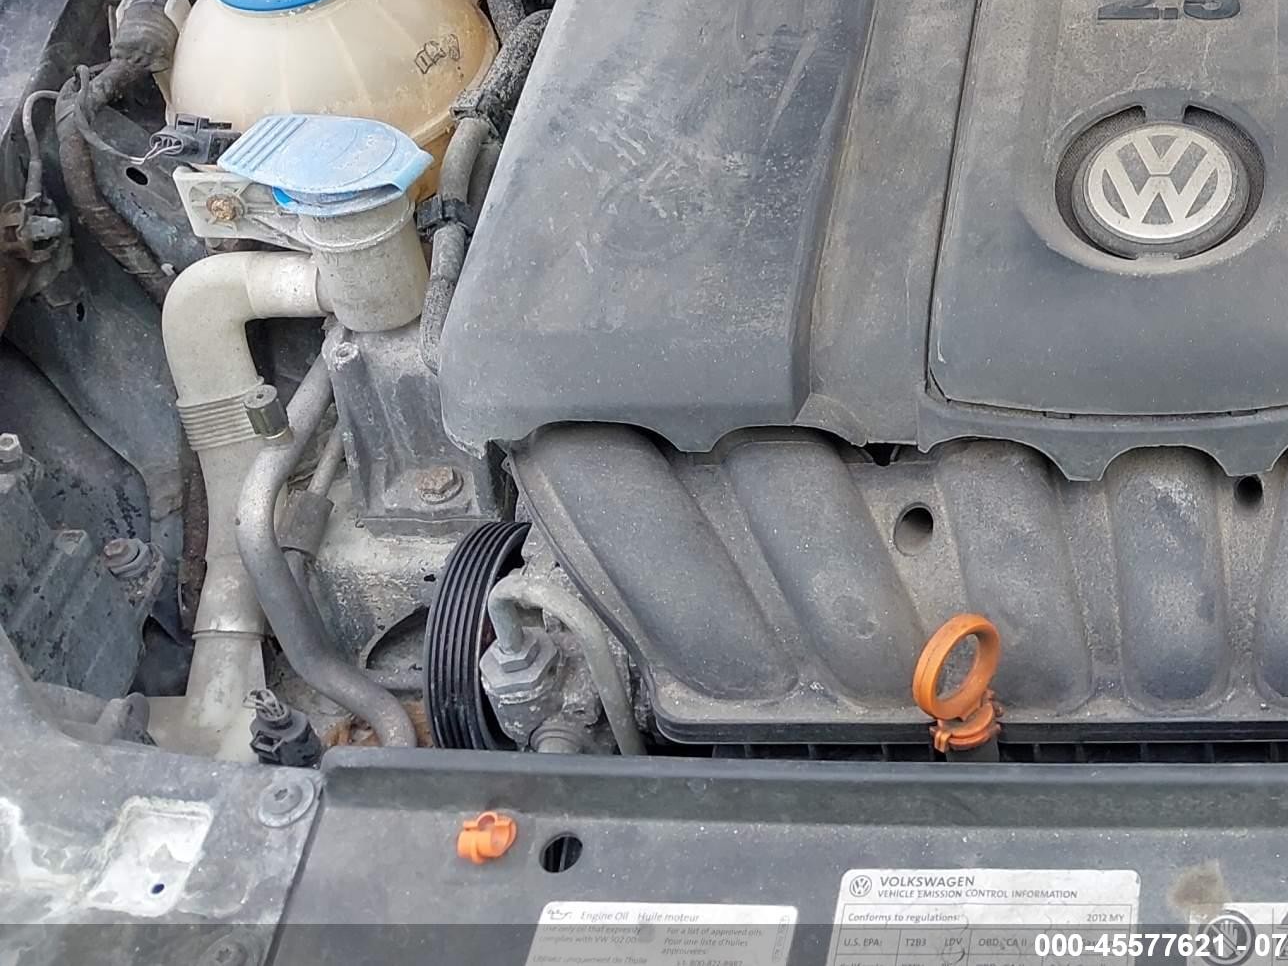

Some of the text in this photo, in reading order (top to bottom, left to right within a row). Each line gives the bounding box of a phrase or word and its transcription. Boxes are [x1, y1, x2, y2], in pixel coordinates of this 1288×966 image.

[880, 876, 976, 887] VOLKSWAGEN
[878, 890, 1078, 898] VEHICLE EMISSION CONTROL INFORMATION
[580, 911, 700, 923] Engine Oil Huile moteur
[848, 913, 960, 924] Conforms to regulations:
[1087, 914, 1125, 922] 2012 MY
[711, 929, 747, 937] approved
[843, 938, 860, 946] U.S.
[944, 938, 963, 946] LDV
